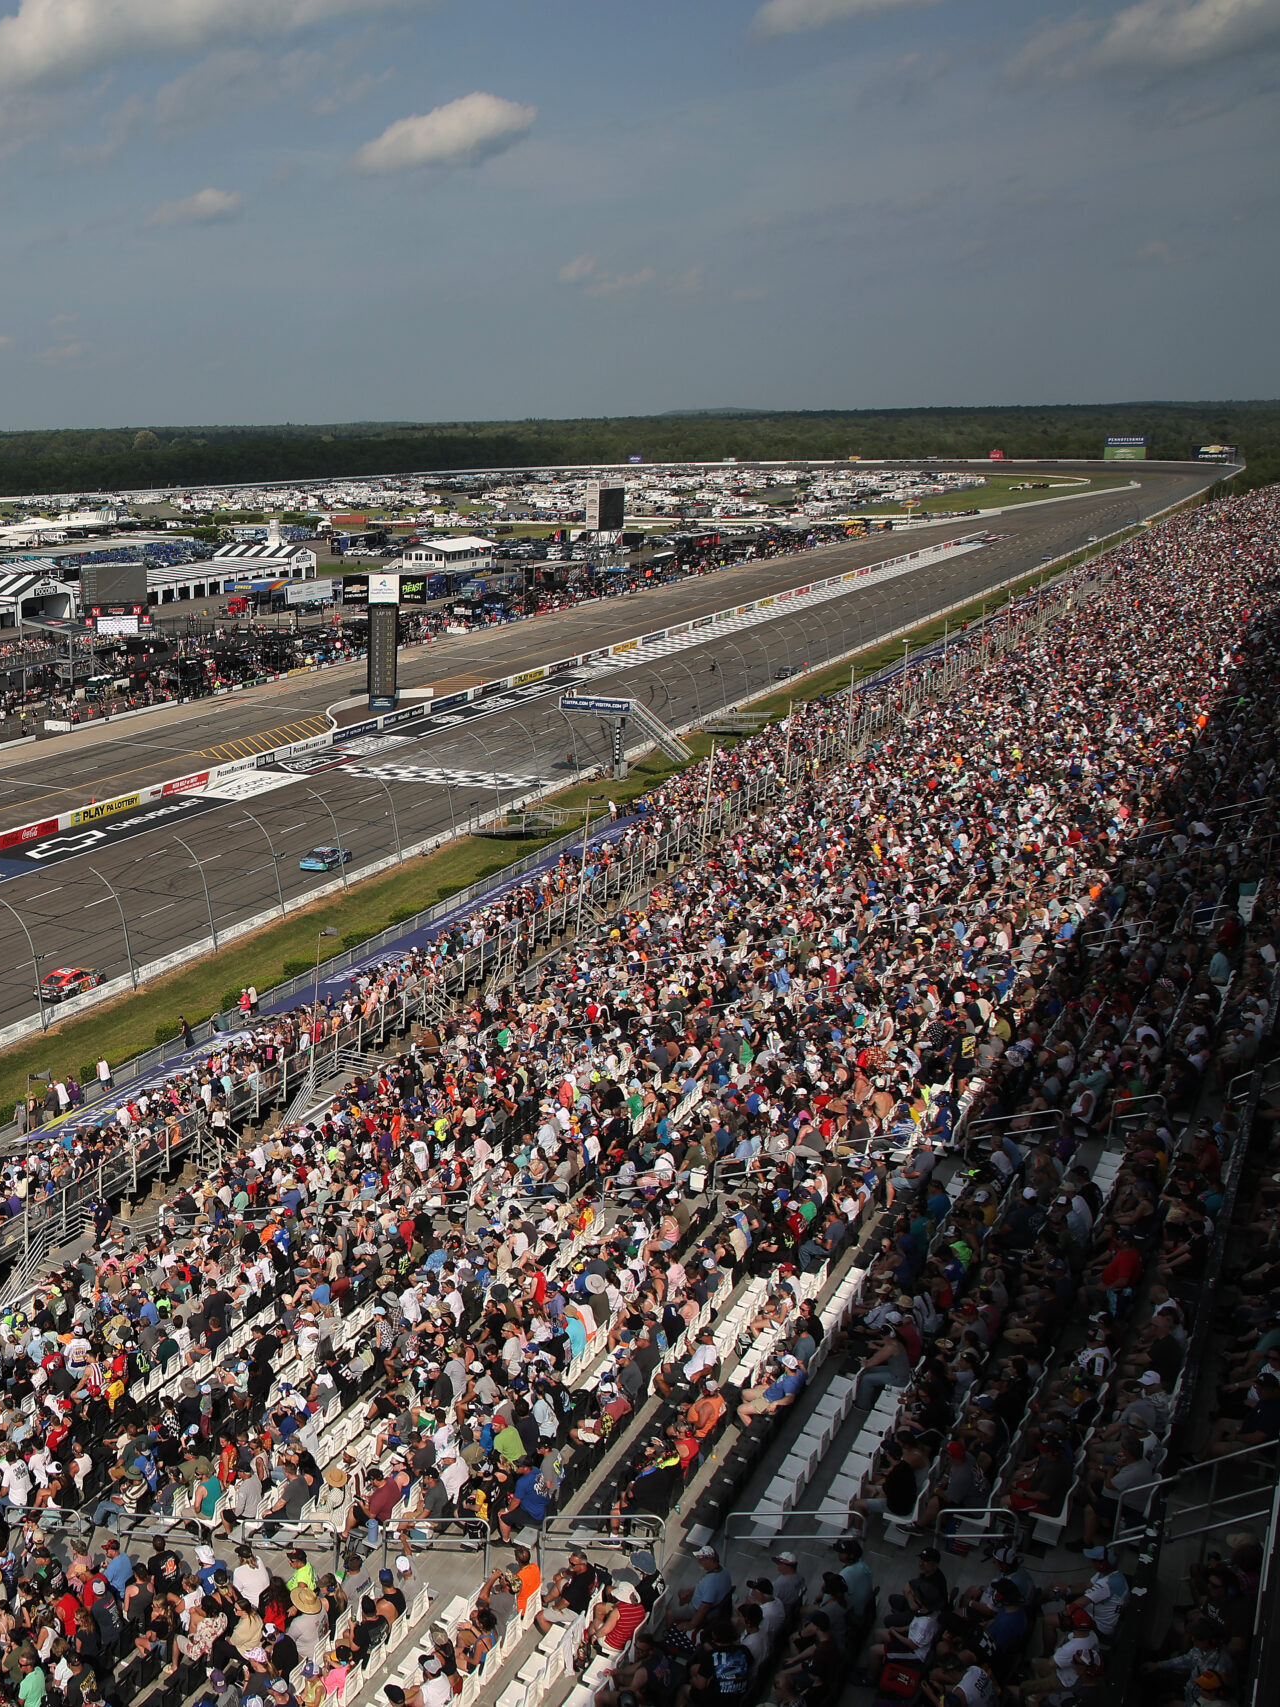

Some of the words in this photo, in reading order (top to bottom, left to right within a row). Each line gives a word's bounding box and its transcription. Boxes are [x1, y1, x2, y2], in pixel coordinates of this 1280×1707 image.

[35, 586, 56, 595] POCONO
[402, 582, 424, 594] BEAST
[82, 805, 105, 821] PLAY
[106, 803, 115, 812] PA
[115, 796, 139, 810] LOTTERY
[106, 798, 205, 831] CHEVROLET
[22, 826, 38, 840] Coca-Cola
[712, 1652, 727, 1666] 11
